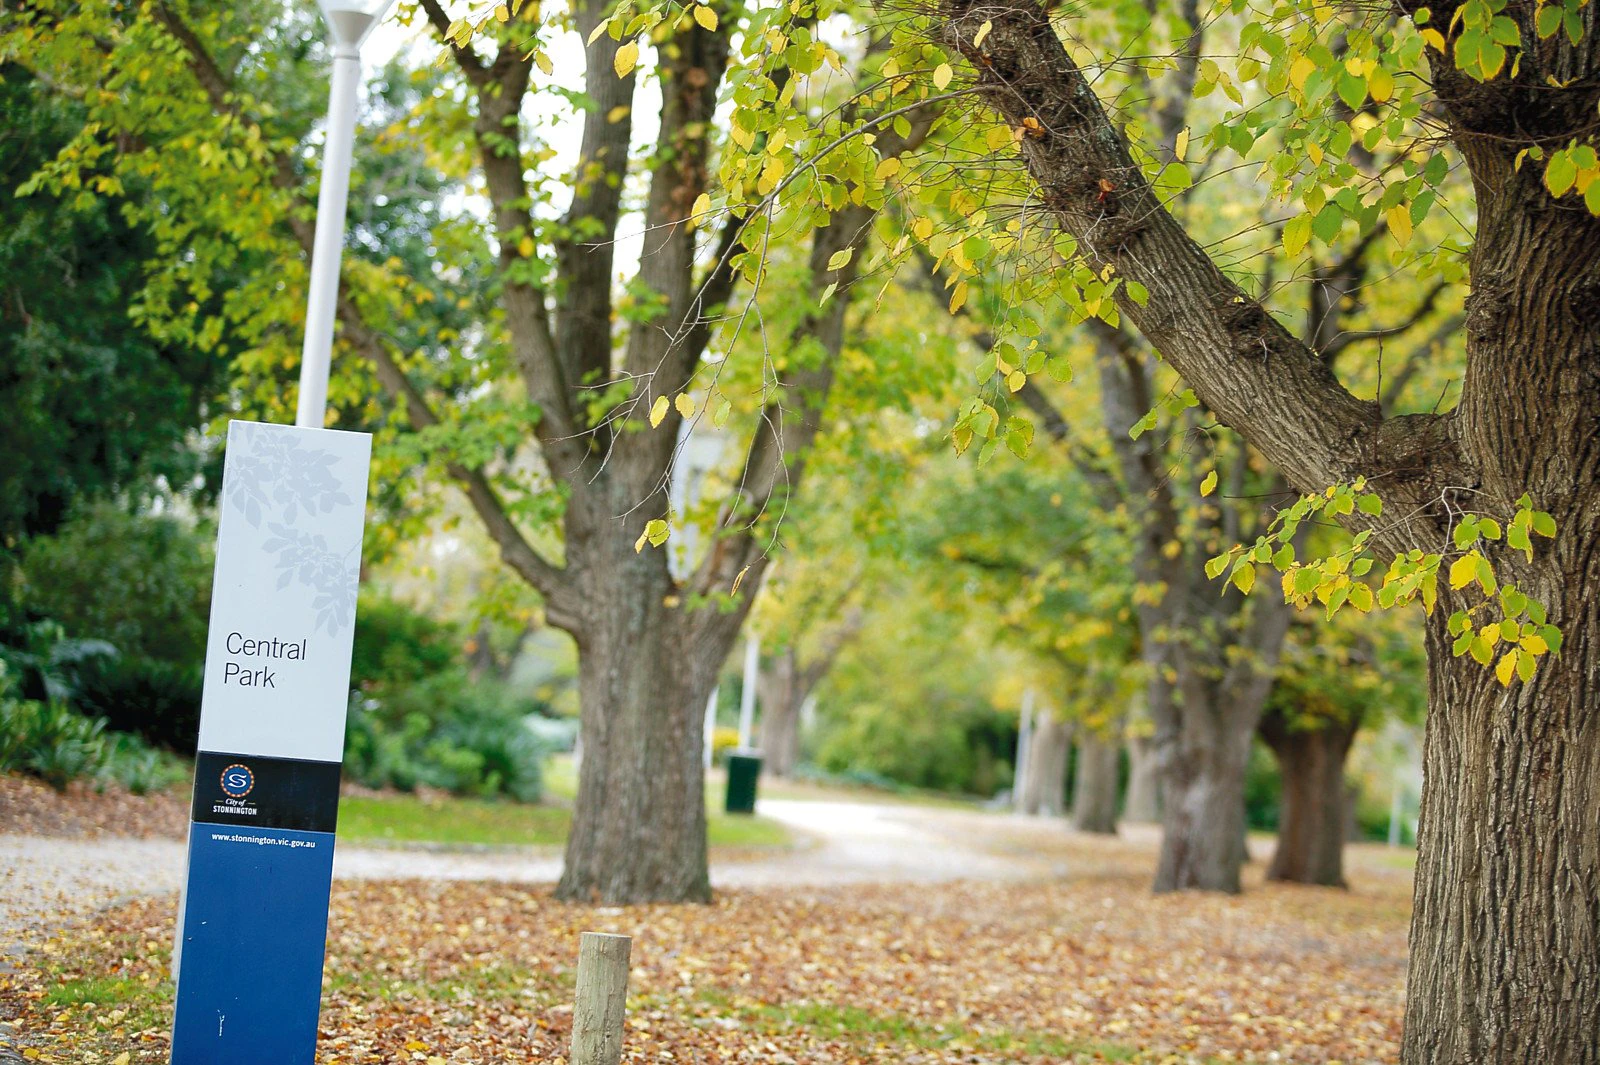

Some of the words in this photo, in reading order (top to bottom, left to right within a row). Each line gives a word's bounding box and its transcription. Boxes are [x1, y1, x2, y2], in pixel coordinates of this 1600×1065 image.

[226, 632, 306, 660] Central
[224, 662, 275, 688] Park
[212, 805, 257, 815] STONNINGTON
[225, 798, 238, 806] City
[238, 799, 247, 807] of
[211, 833, 316, 848] www.stonnington.vic.gov.au
